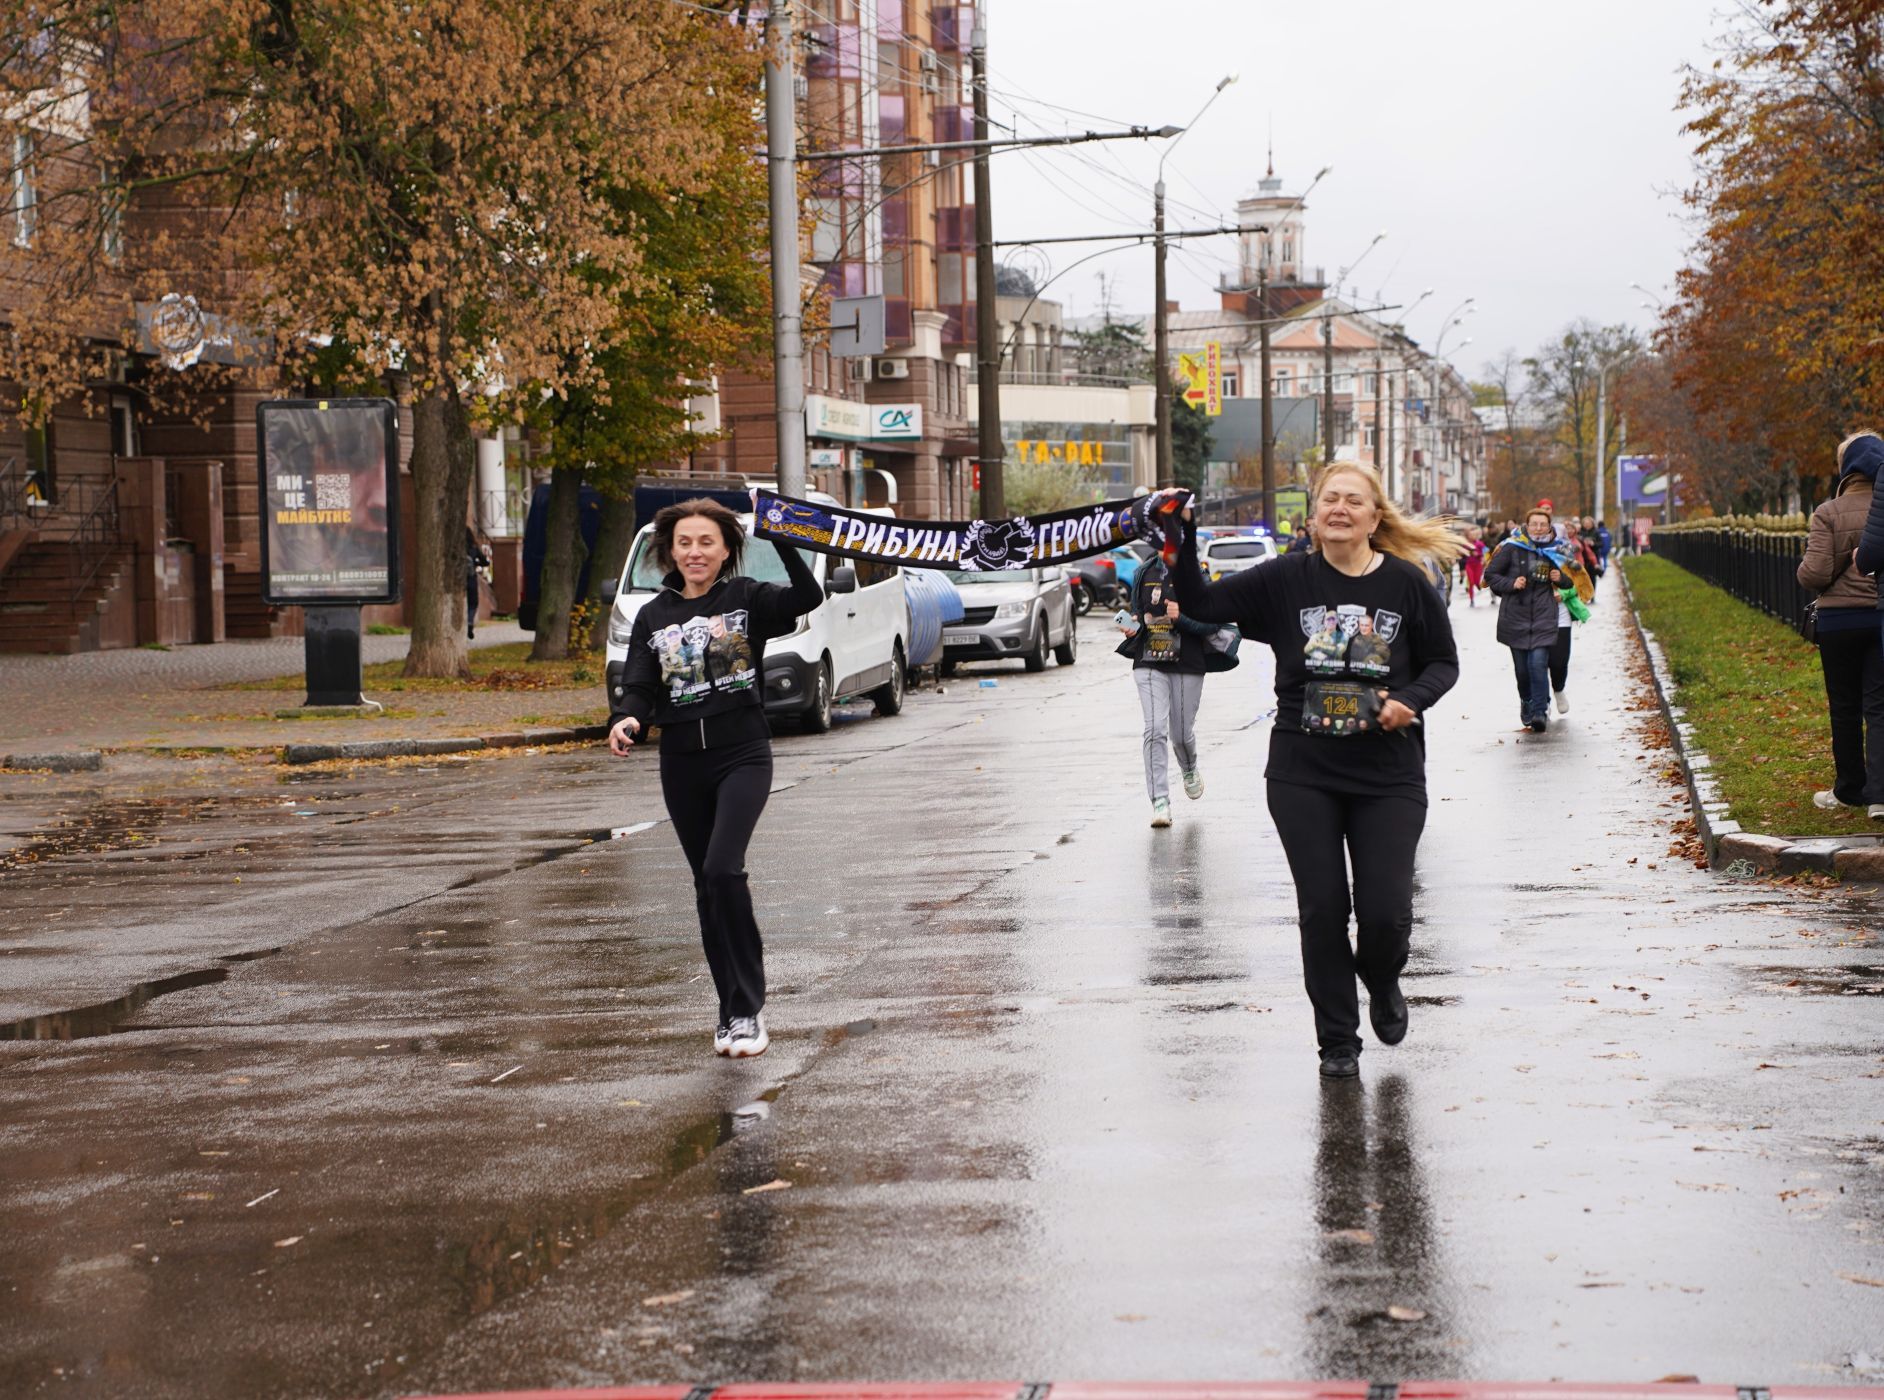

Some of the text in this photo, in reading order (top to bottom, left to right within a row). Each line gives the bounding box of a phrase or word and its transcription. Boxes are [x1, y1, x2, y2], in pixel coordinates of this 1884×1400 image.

[277, 475, 303, 490] МИ
[285, 492, 305, 509] ЦЕ
[277, 509, 352, 524] МАЙБУТНЄ
[829, 514, 957, 562] ТРИБУНА
[1038, 507, 1114, 560] ГЕРОЇВ
[1323, 696, 1358, 715] 124
